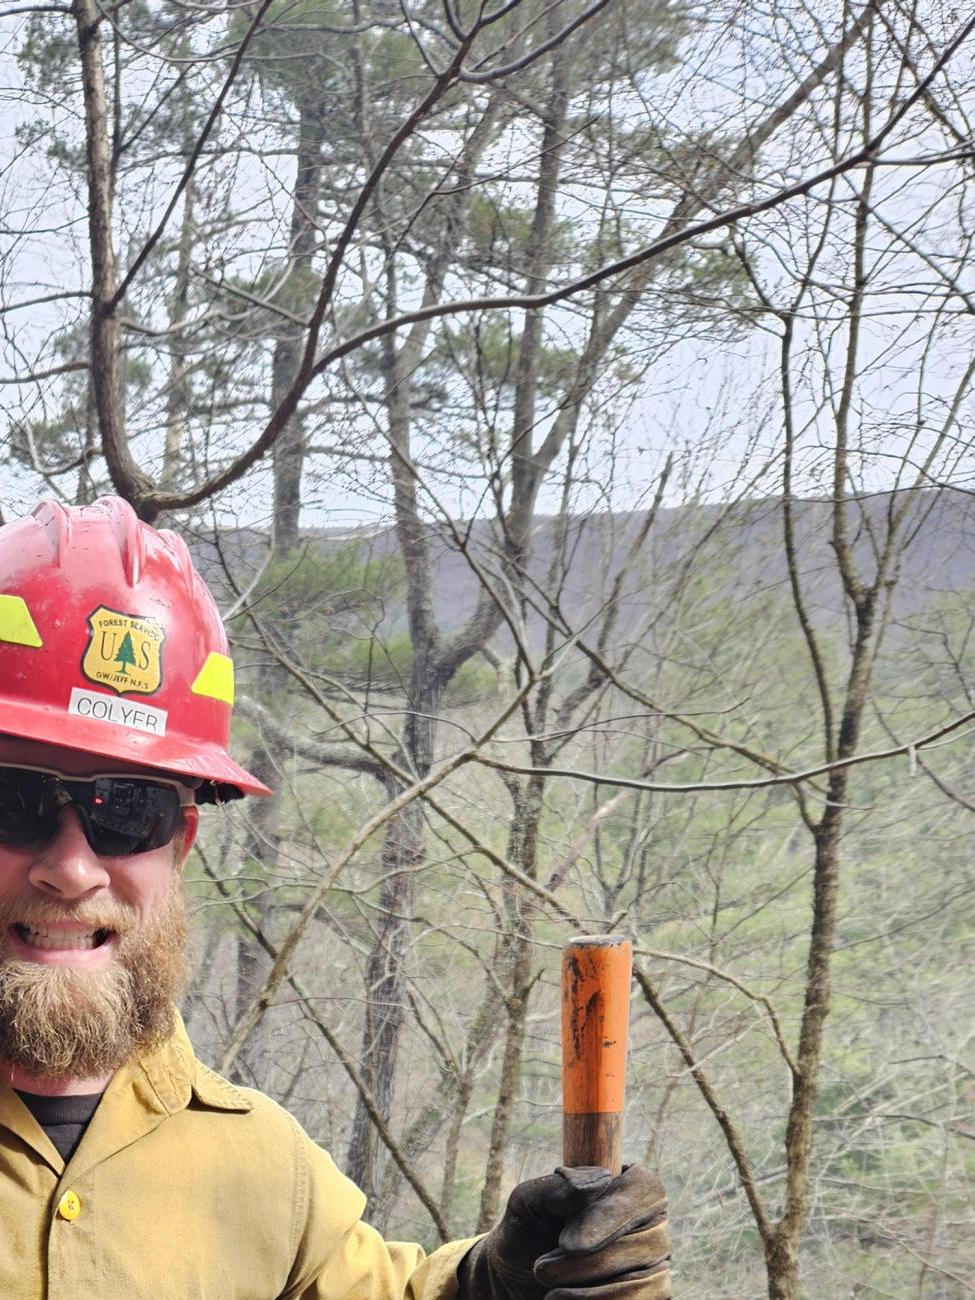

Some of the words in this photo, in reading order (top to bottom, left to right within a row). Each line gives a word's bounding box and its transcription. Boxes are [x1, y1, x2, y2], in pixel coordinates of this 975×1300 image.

[98, 619, 127, 628] FOREST
[101, 631, 117, 661] U
[138, 641, 151, 671] S
[96, 671, 128, 684] GW/JEFF
